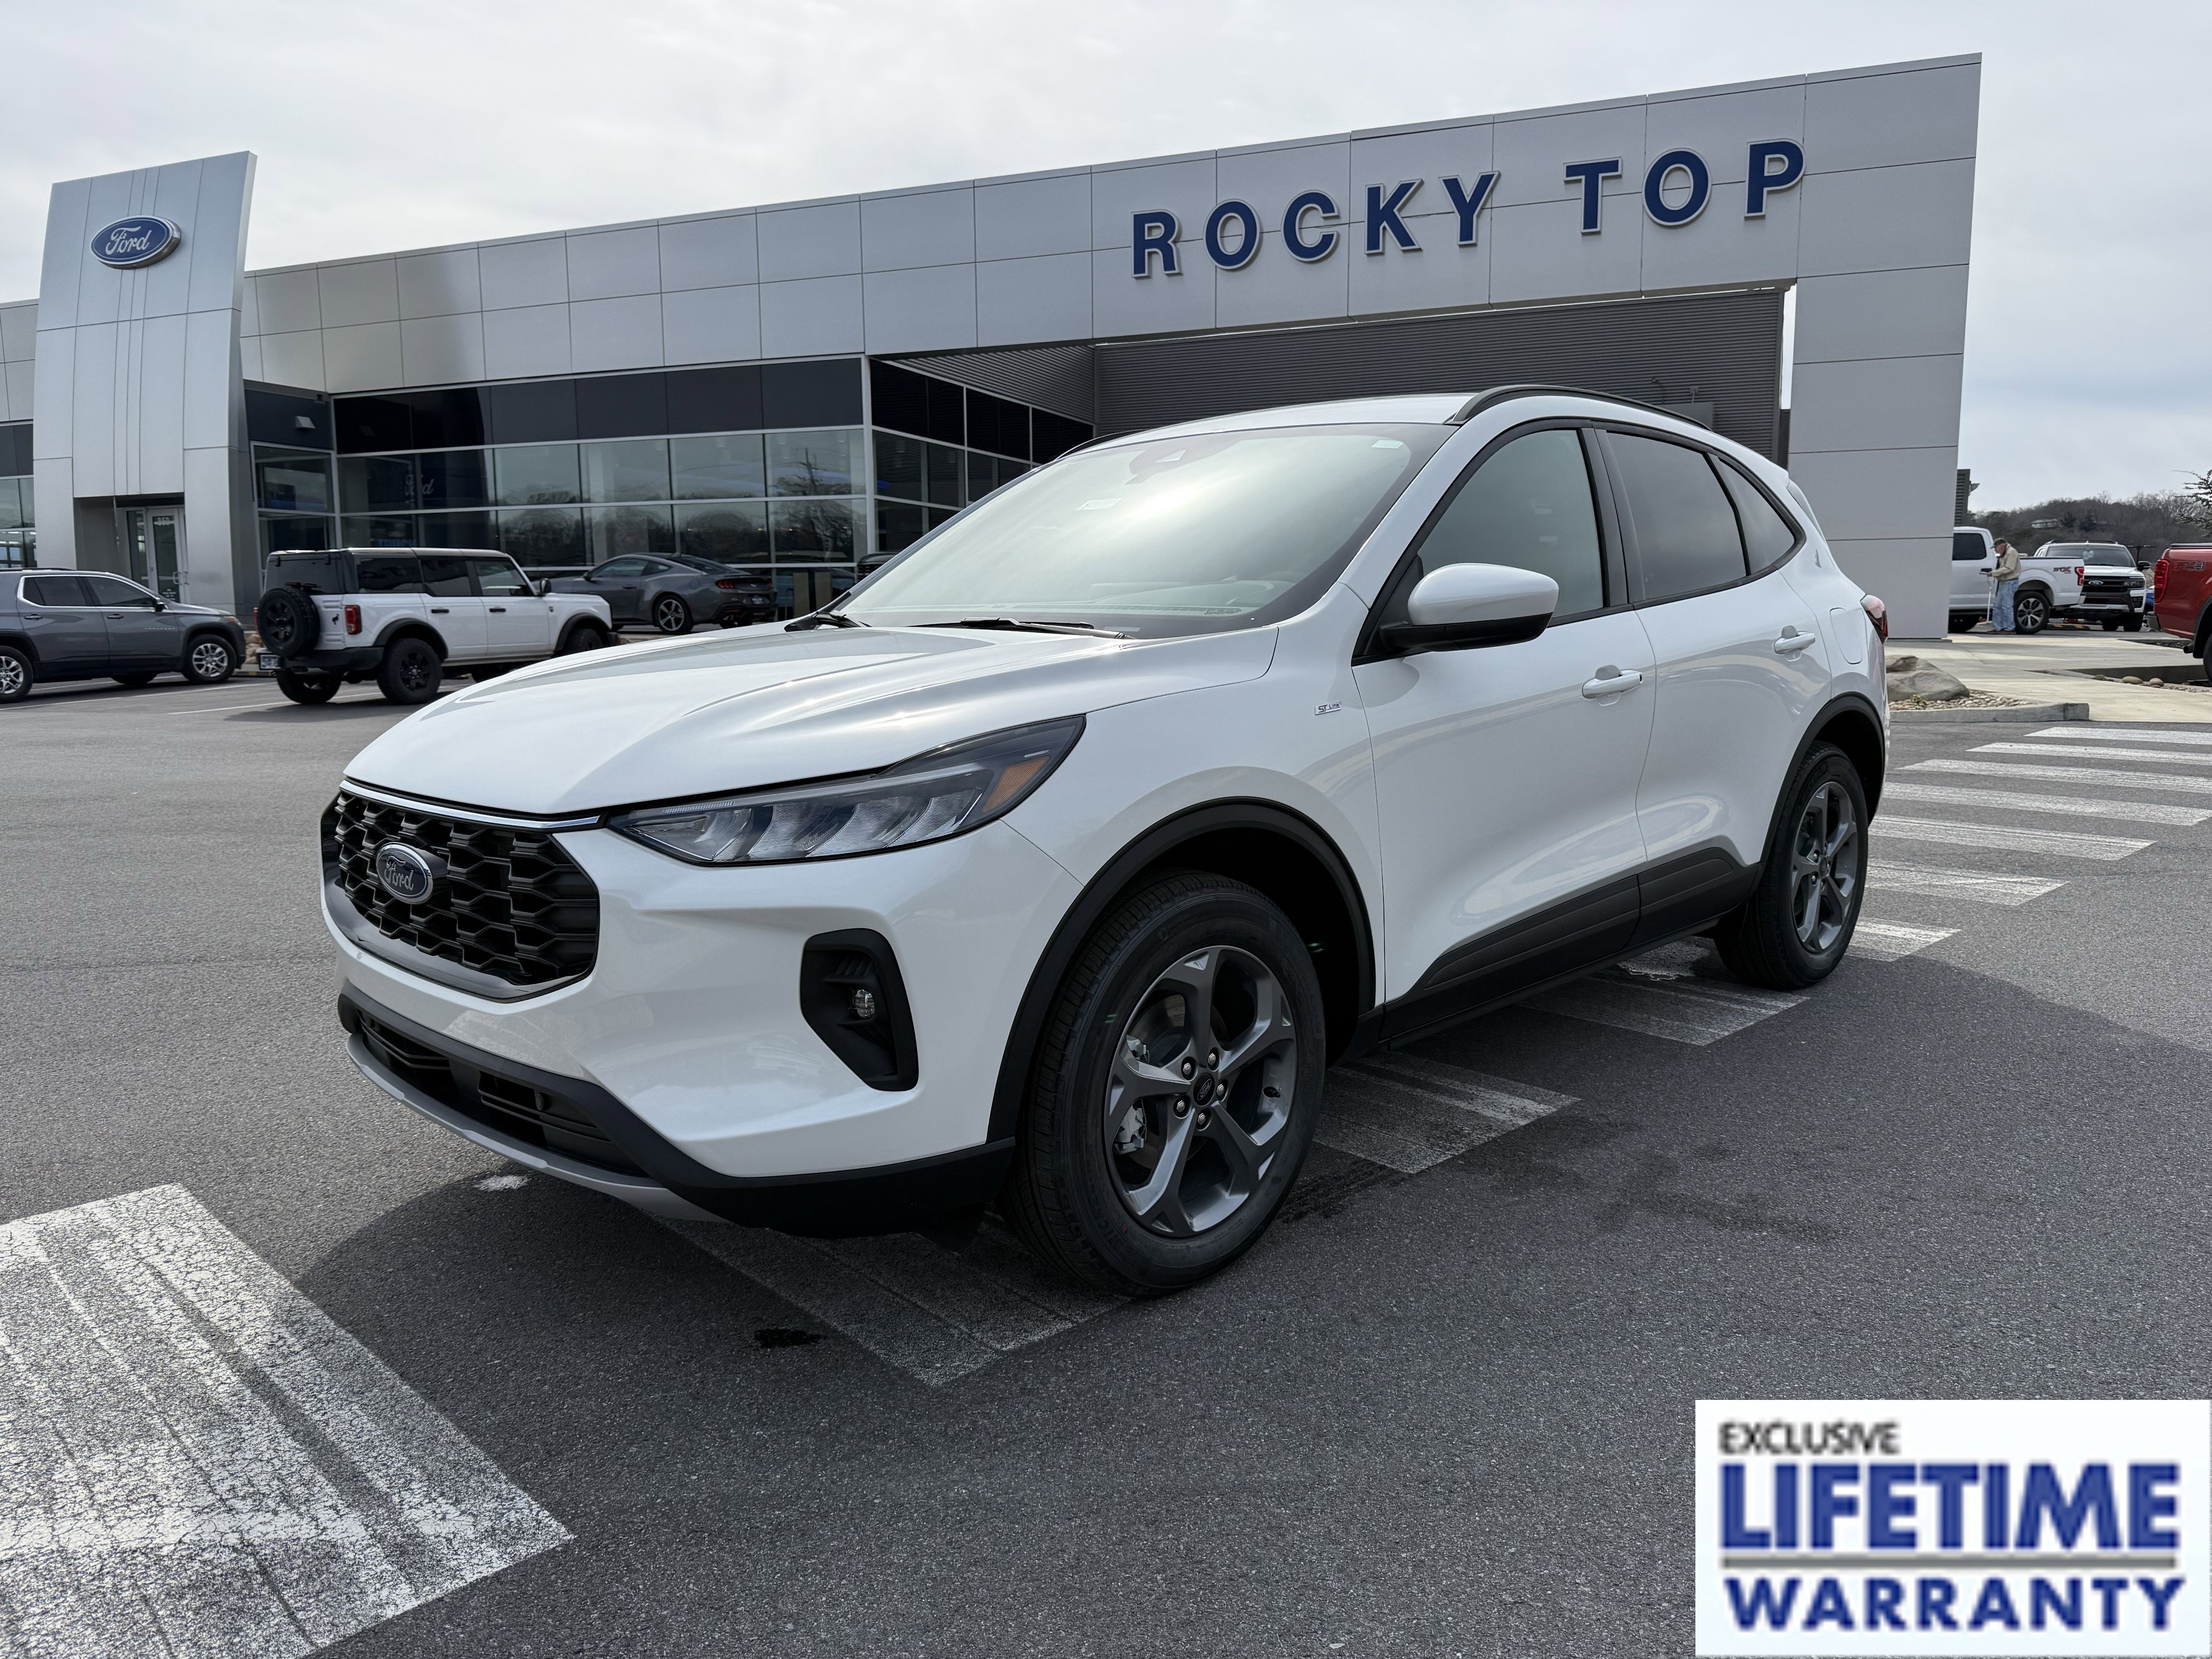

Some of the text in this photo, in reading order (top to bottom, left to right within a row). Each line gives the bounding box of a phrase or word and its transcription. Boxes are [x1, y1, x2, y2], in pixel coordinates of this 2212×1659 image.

[1134, 142, 1802, 274] ROCKY TOP
[105, 226, 152, 255] Ford
[1318, 704, 1328, 713] ST
[384, 855, 414, 890] Ford
[1200, 1082, 1209, 1097] Ford
